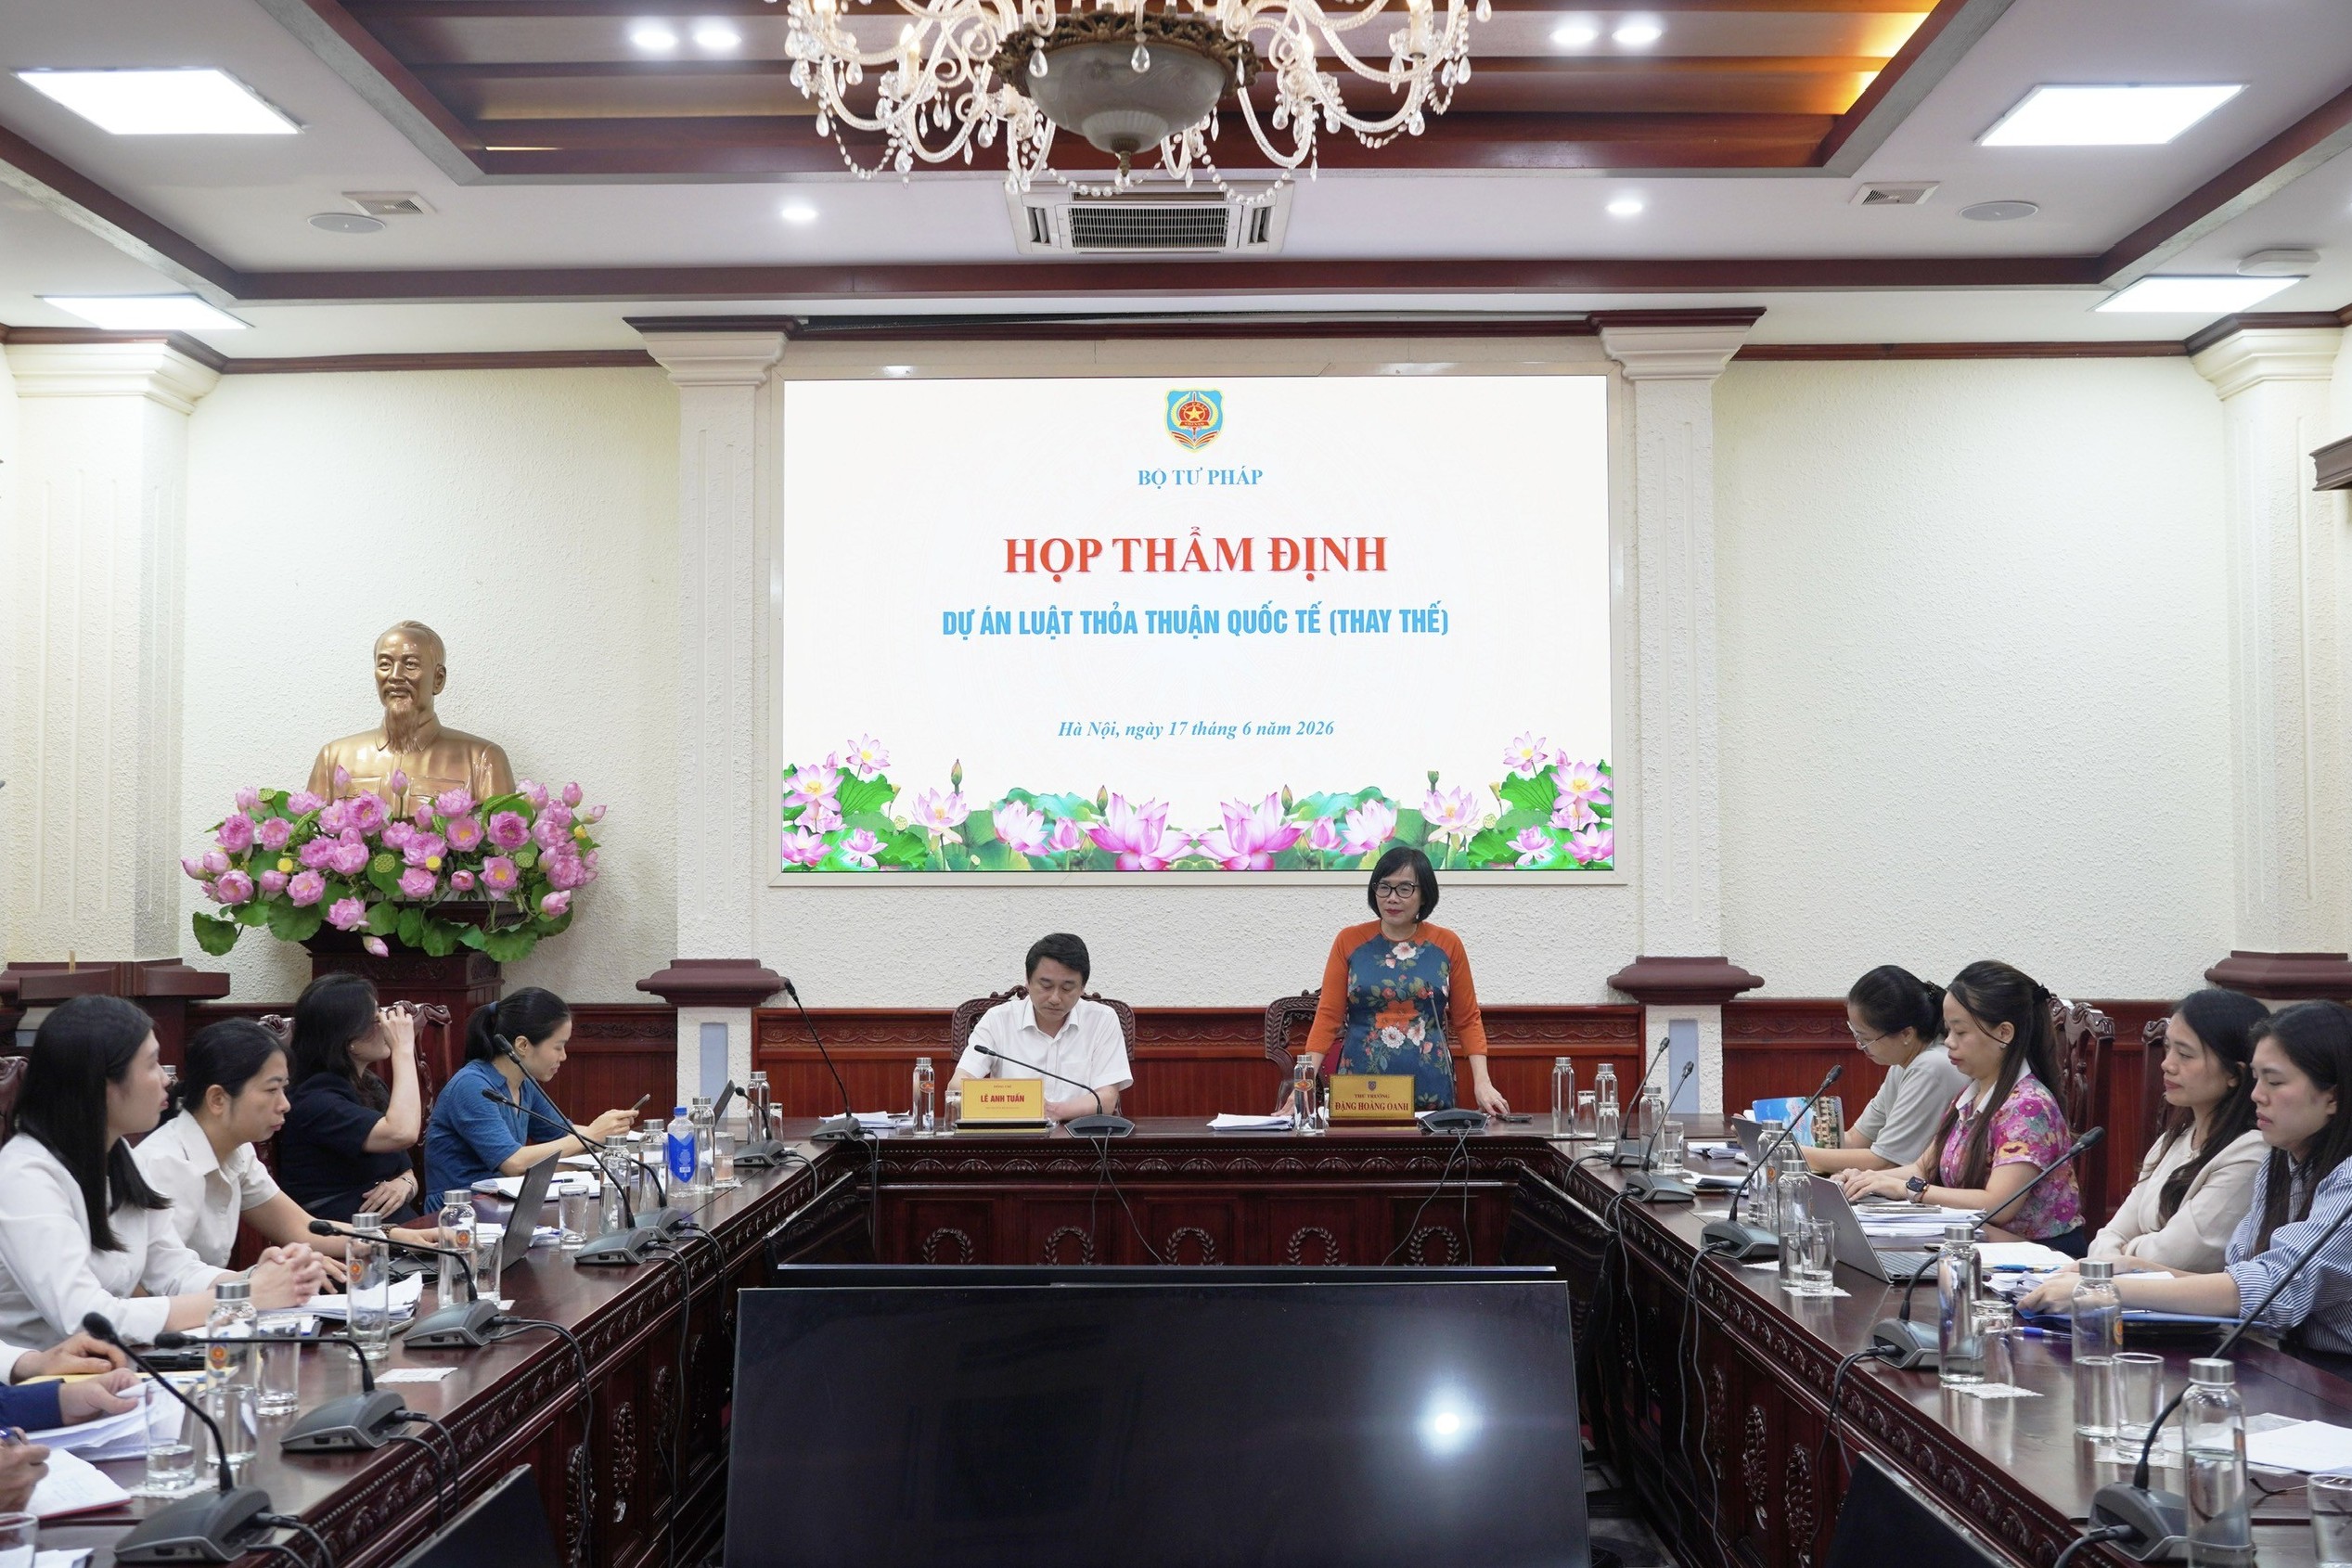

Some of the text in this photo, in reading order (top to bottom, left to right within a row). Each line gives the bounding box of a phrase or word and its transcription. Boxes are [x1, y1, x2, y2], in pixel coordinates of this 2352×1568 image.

[1138, 466, 1264, 490] BỘ TƯ PHÁP
[1004, 526, 1388, 584] HỌP THẨM ĐỊNH
[942, 599, 1449, 640] DỰ ÁN LUẬT THỎA THUẬN QUỐC TẾ (THAY THẾ)
[1058, 720, 1335, 740] Hà Nội, ngày 17 tháng 6 năm 2026
[1358, 1099, 1385, 1111] HOÀNG
[1387, 1102, 1408, 1111] OANH
